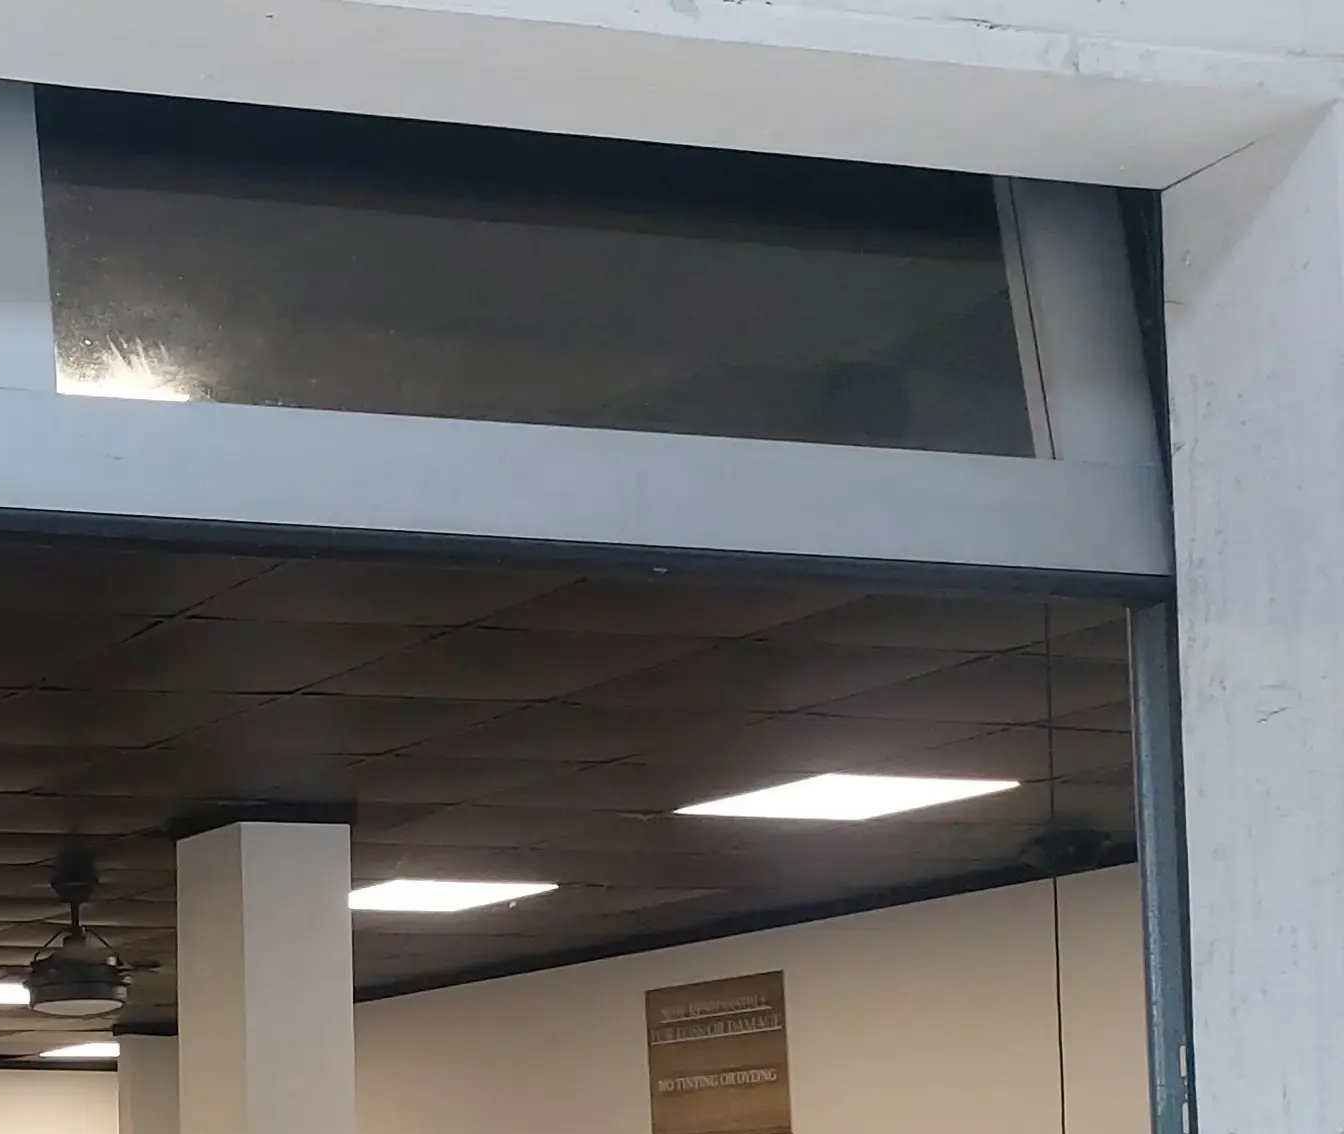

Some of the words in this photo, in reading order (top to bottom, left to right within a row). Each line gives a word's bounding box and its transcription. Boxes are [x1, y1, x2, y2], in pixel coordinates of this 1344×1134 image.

[658, 1079, 674, 1092] NO
[676, 1075, 718, 1090] TINTING
[719, 1072, 737, 1085] OR
[737, 1068, 777, 1085] DYEING
